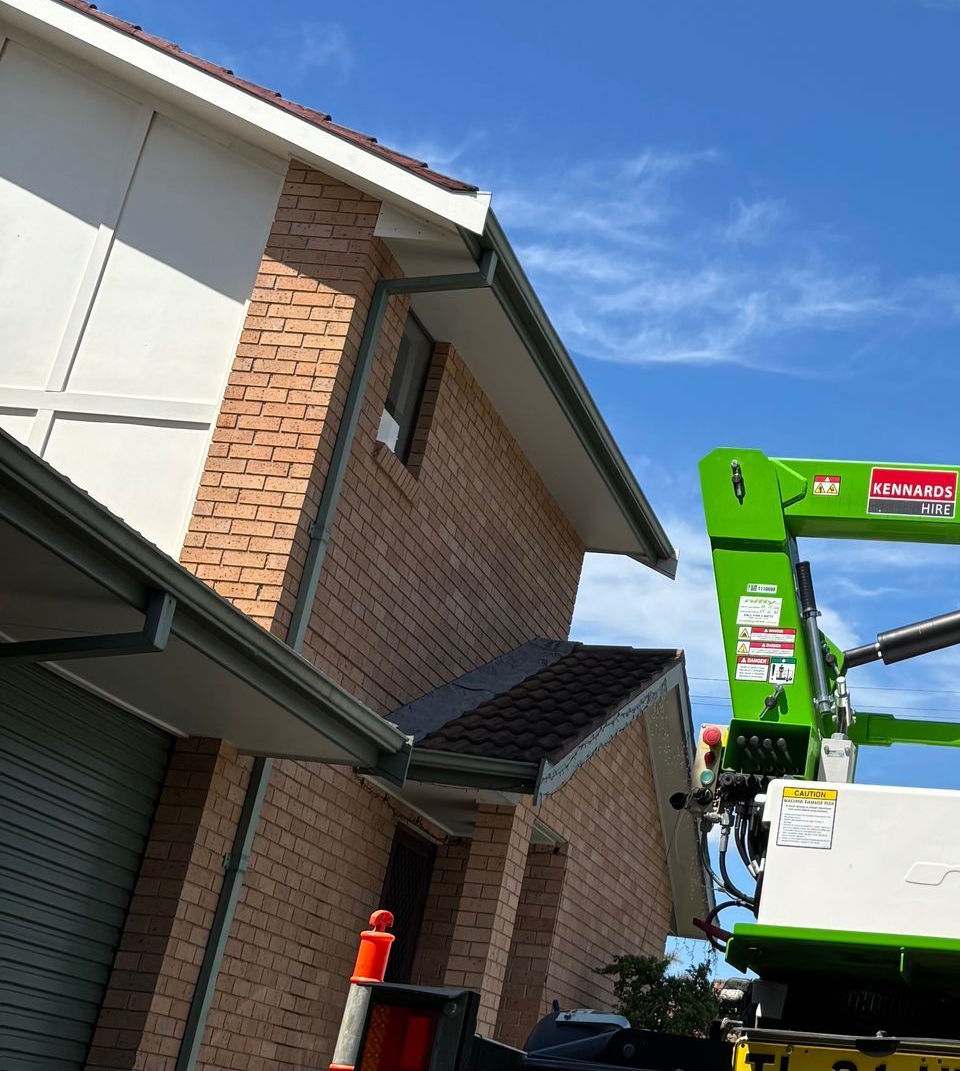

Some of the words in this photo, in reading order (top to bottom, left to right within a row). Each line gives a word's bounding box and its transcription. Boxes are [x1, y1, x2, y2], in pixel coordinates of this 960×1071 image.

[873, 482, 953, 498] KENNARDS
[921, 503, 951, 516] HIRE
[794, 790, 826, 798] CAUTION
